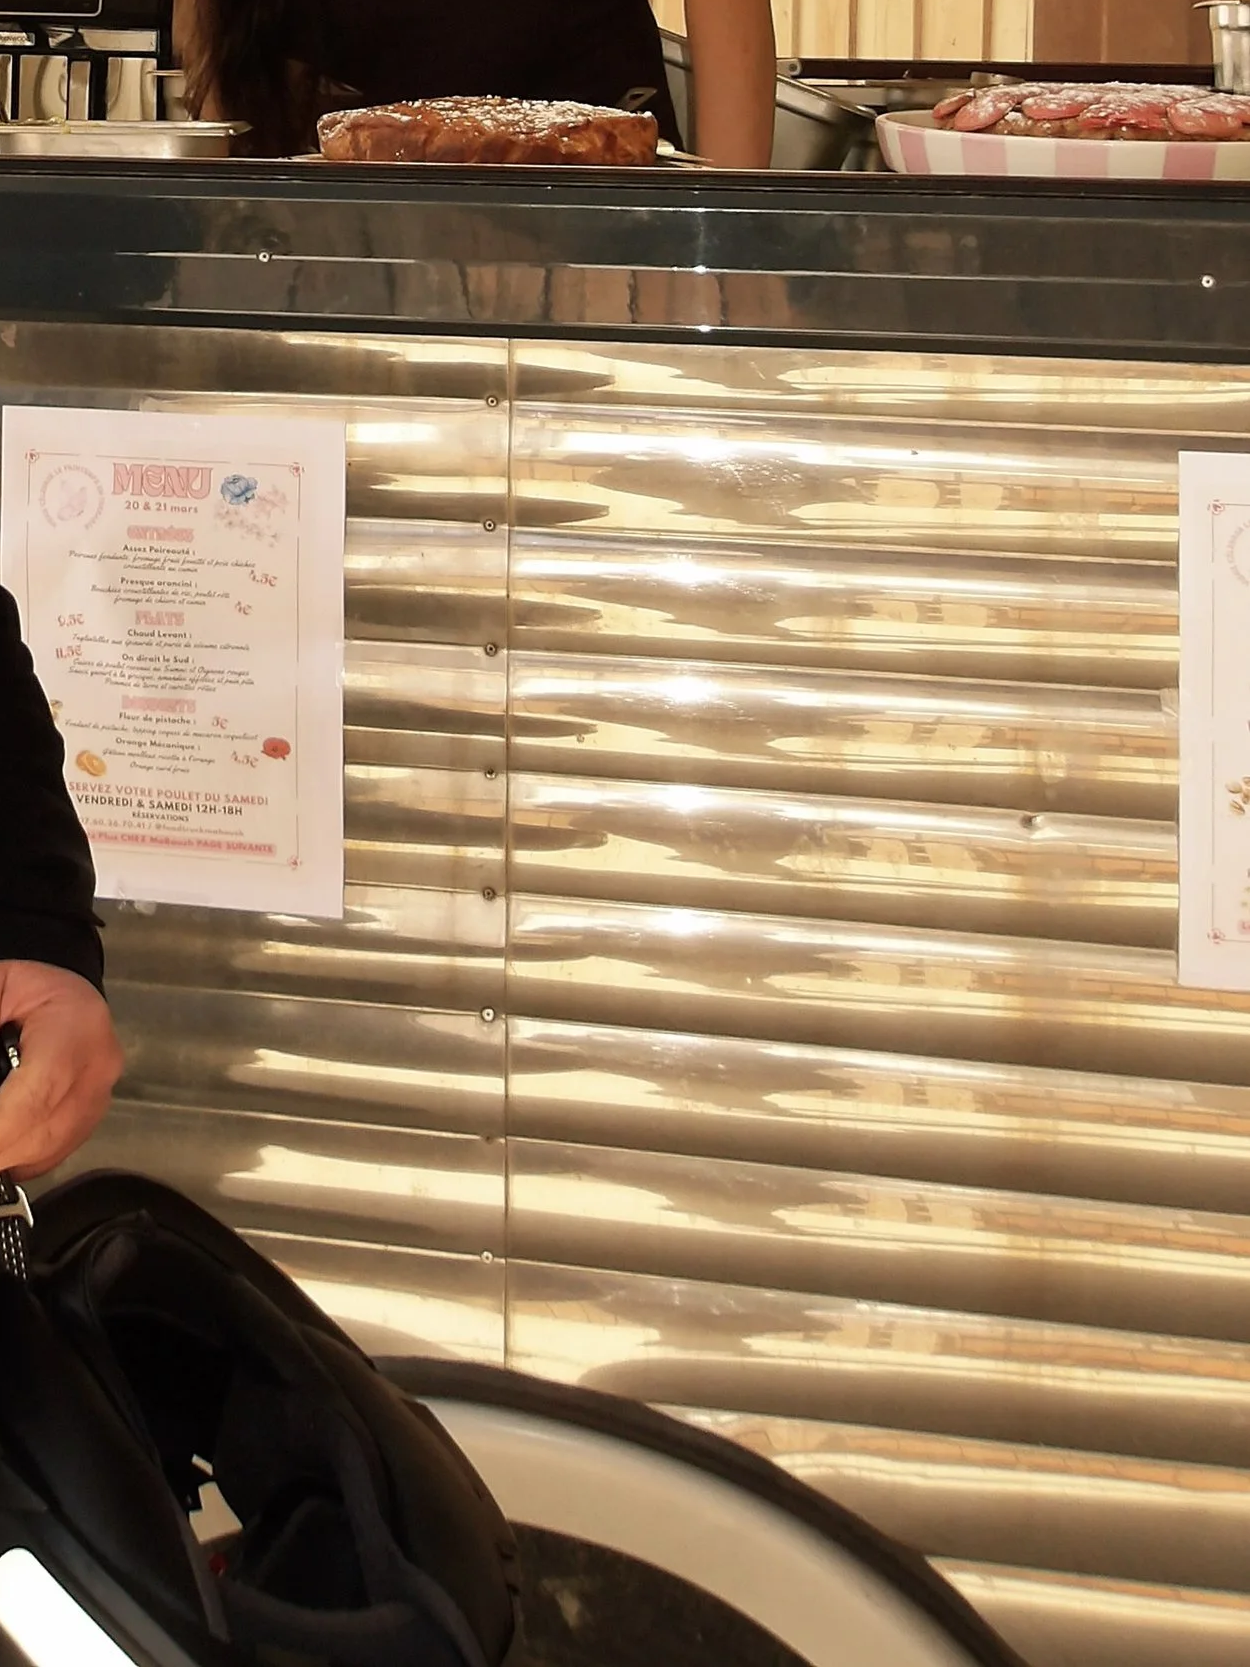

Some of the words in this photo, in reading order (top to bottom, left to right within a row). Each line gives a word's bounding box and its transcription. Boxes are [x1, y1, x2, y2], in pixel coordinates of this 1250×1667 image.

[111, 462, 214, 500] MENU
[125, 500, 139, 511] 20
[143, 501, 150, 511] &
[155, 502, 167, 512] 21
[170, 504, 198, 514] mars
[120, 576, 155, 586] Presque
[127, 628, 155, 637] Chaud
[157, 630, 187, 639] Levant
[122, 653, 134, 662] On
[136, 654, 160, 663] dirait
[162, 655, 171, 663] le
[173, 655, 190, 664] Sud
[142, 713, 153, 723] de
[115, 784, 153, 798] VOTRE
[156, 789, 200, 801] POULET
[204, 792, 221, 802] DU
[224, 793, 269, 806] SAMEDI
[76, 794, 133, 808] VENDREDI
[136, 799, 145, 809] &
[148, 799, 192, 813] SAMEDI
[196, 803, 243, 816] 12H-18H
[132, 810, 190, 822] RÉSERVATIONS
